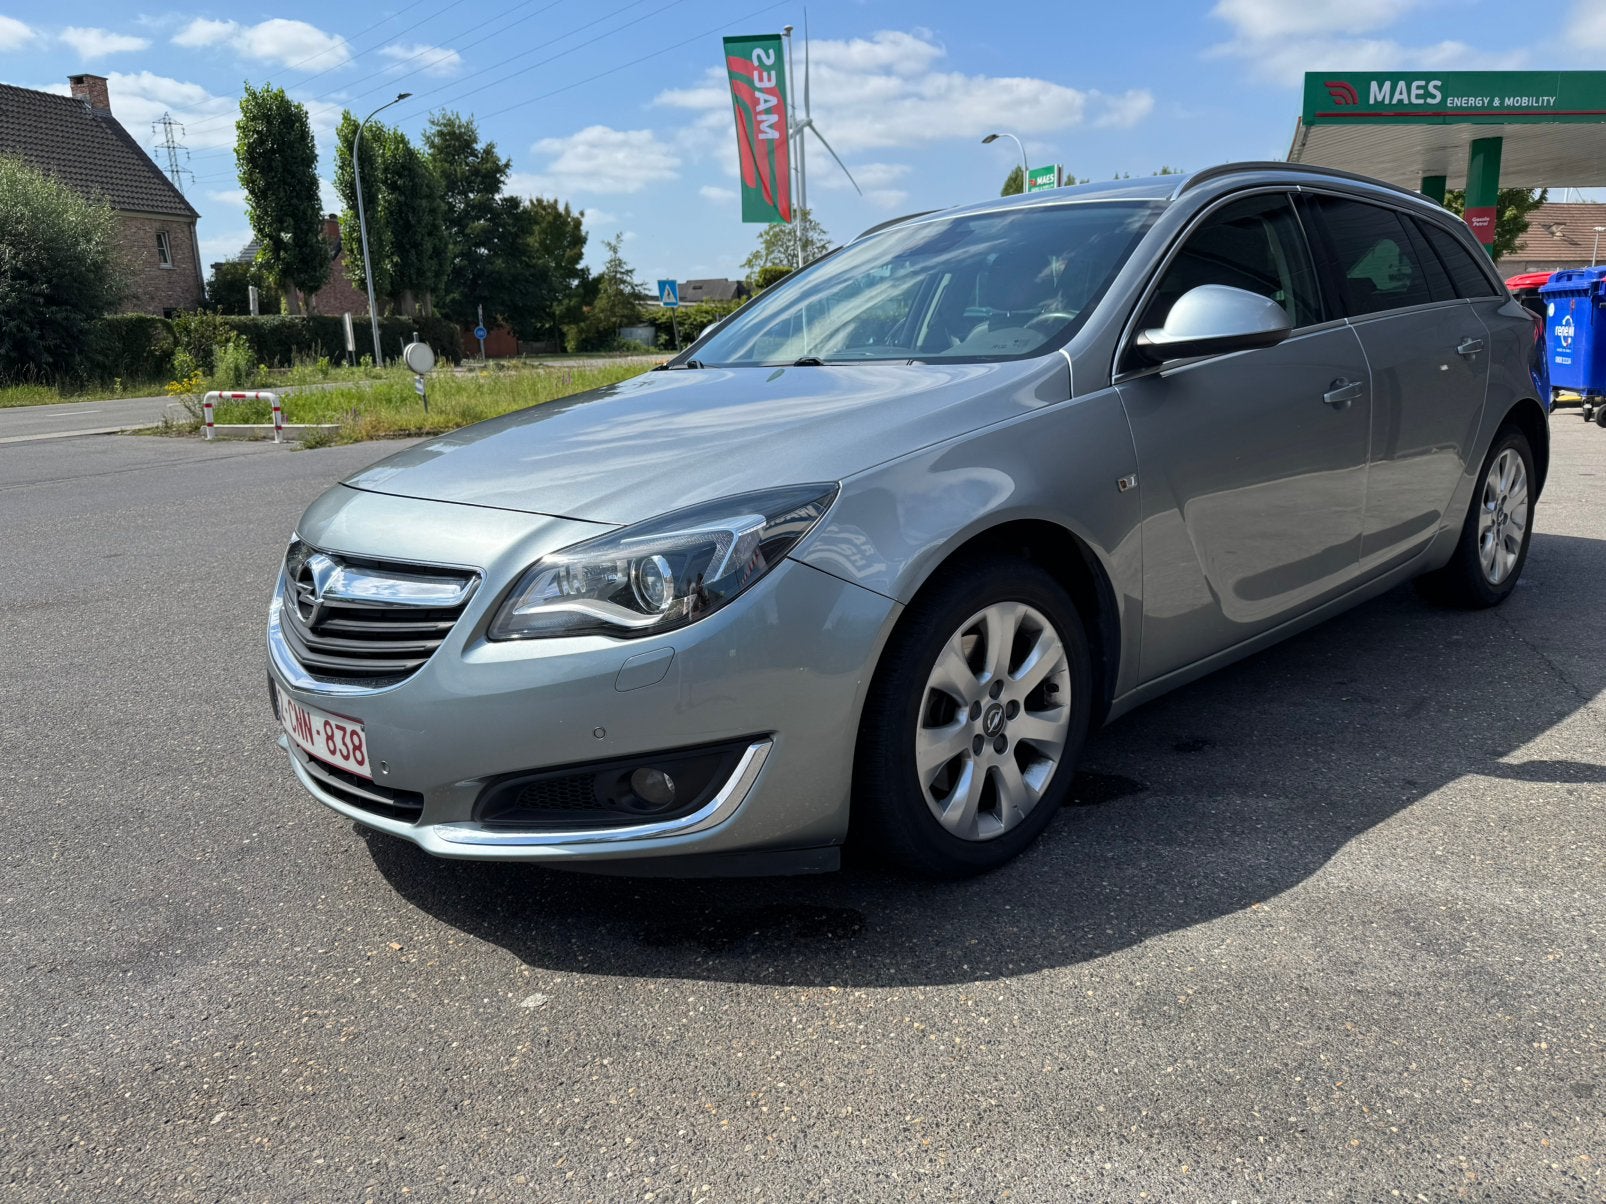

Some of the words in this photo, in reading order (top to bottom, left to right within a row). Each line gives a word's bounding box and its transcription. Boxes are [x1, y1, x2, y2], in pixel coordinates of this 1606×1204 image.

[1369, 80, 1442, 104] MAES
[1447, 97, 1490, 107] ENERGY
[1493, 97, 1501, 107] &
[1504, 96, 1556, 107] MOBILITY
[1037, 173, 1054, 186] MAES
